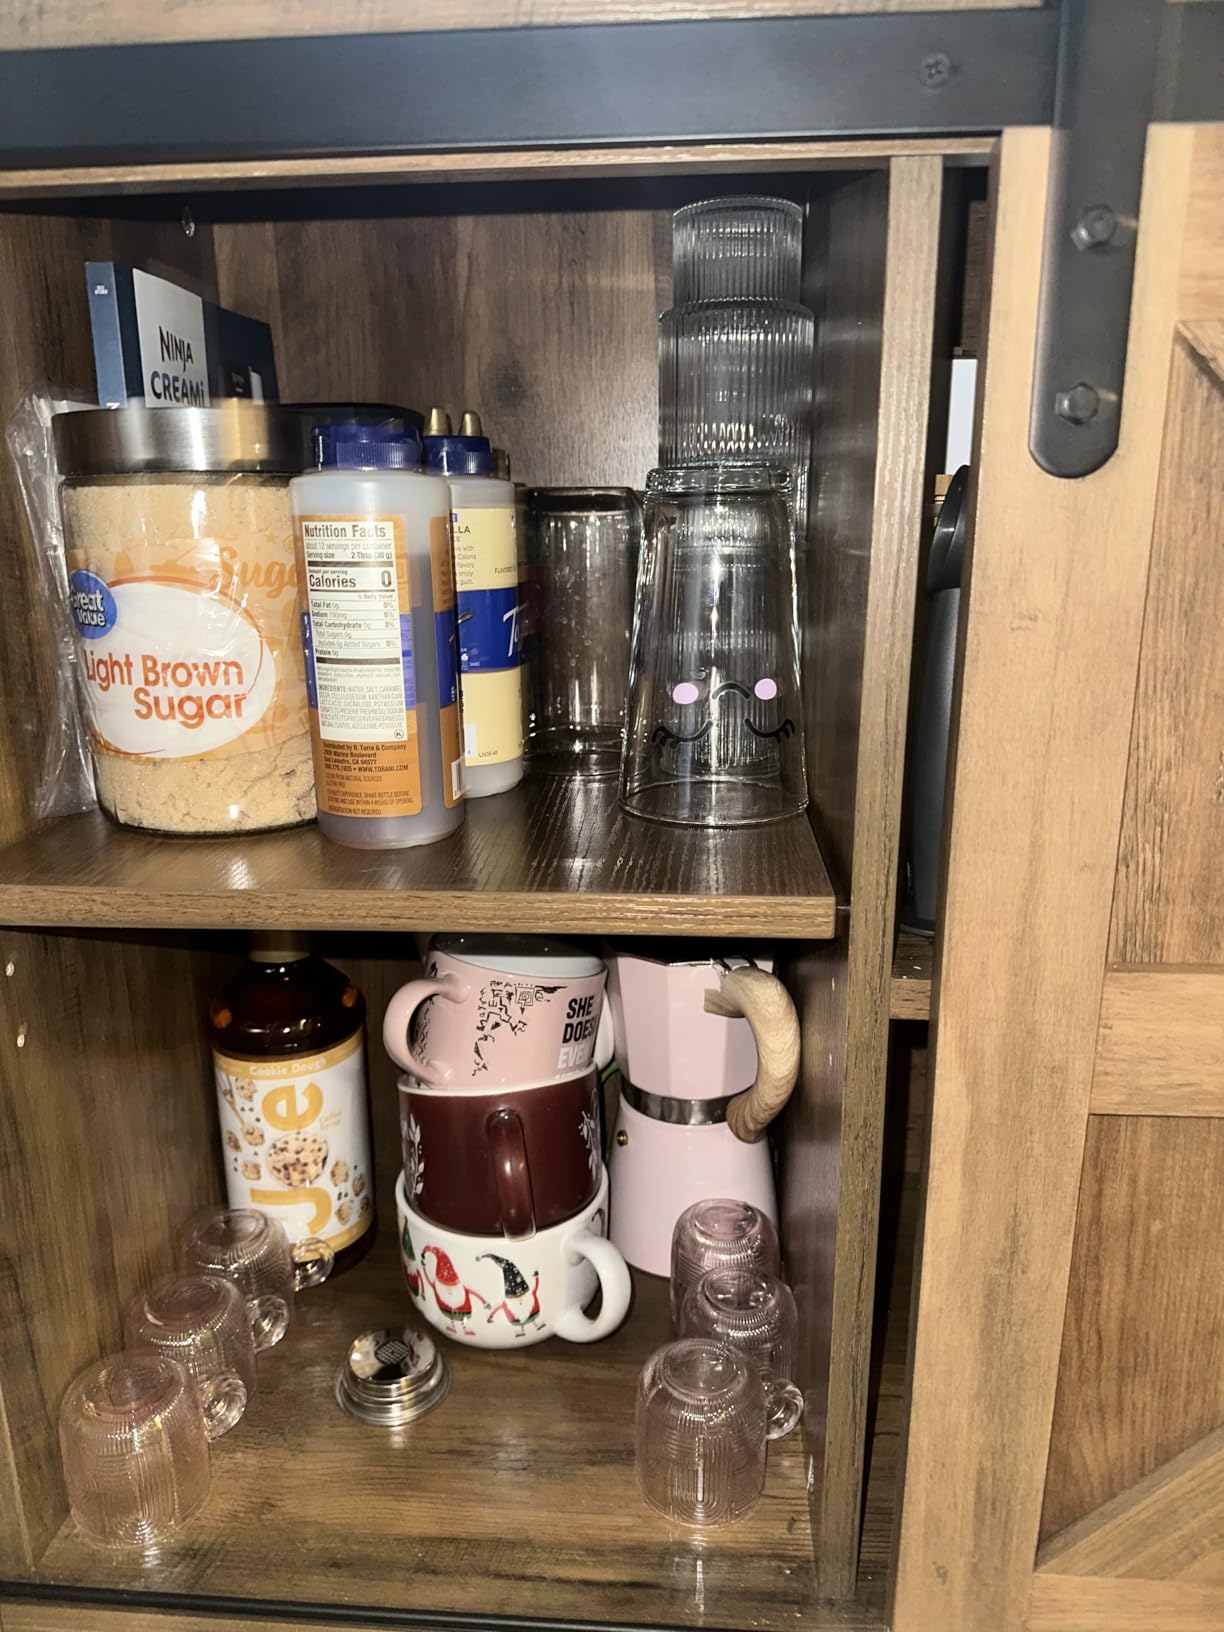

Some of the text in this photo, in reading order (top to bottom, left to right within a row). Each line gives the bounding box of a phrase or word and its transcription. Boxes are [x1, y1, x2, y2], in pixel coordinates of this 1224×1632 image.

[159, 325, 194, 372] NINJA
[151, 370, 205, 407] CREAMi
[304, 524, 386, 538] Nutrition Facts
[324, 551, 335, 559] size
[309, 570, 392, 588] Calories 0
[76, 607, 106, 627] Value
[324, 620, 362, 630] Carbohydrate
[84, 650, 244, 692] Light Brown
[134, 687, 247, 730] Sugar
[382, 744, 407, 752] Company
[358, 764, 408, 774] WWW.TORANI.COM
[566, 995, 595, 1020] SHE
[250, 1058, 327, 1076] Cookie Dough
